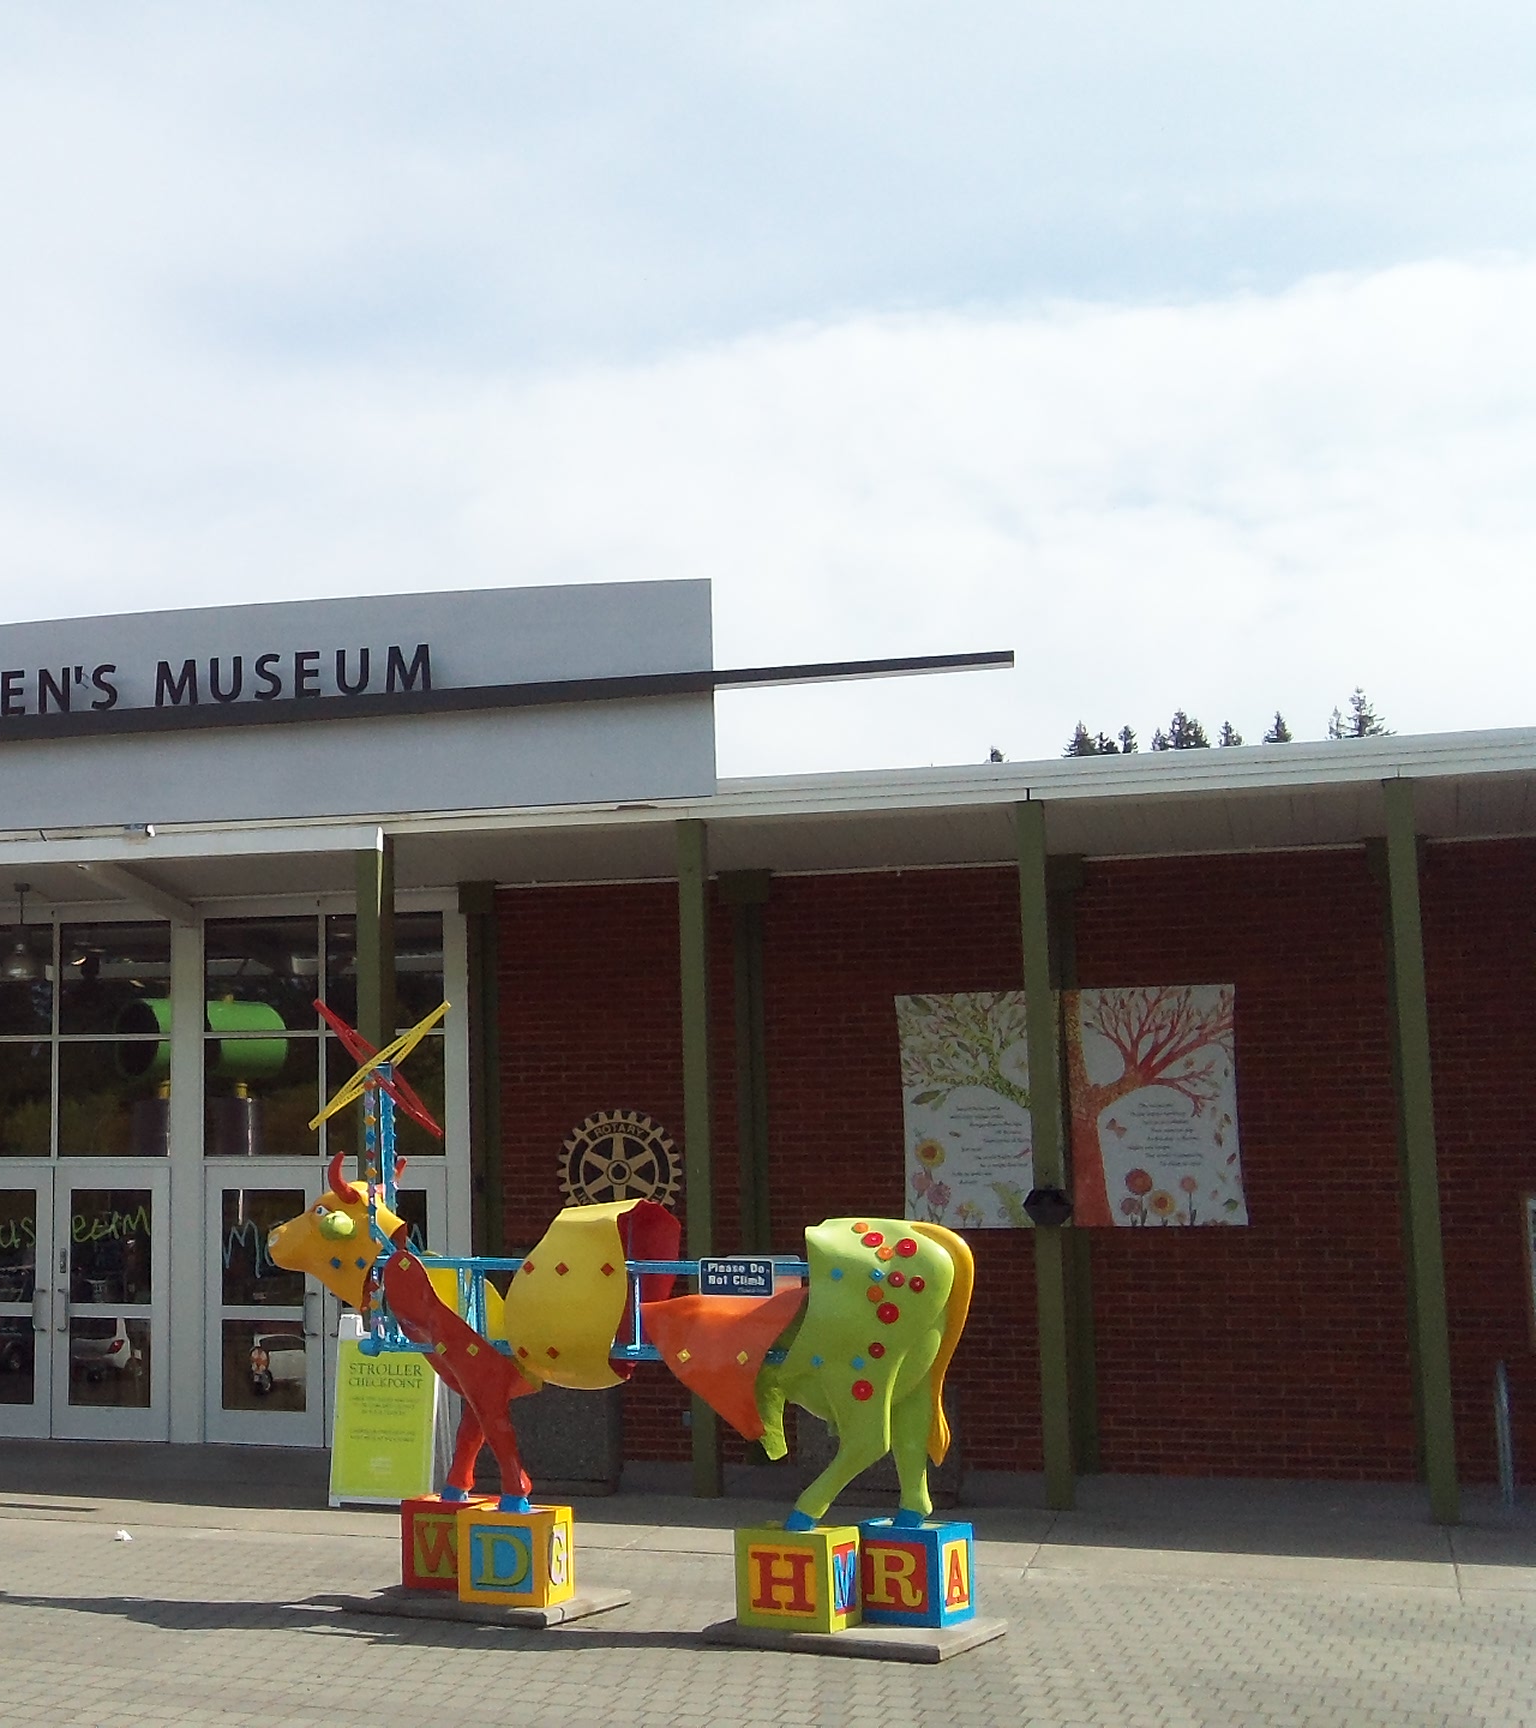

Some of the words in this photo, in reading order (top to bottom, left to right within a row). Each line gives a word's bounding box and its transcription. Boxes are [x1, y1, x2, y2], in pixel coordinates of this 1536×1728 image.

[154, 642, 432, 706] MUSEUM
[593, 1122, 645, 1138] ROTARY
[707, 1262, 745, 1273] Please
[750, 1263, 765, 1274] Do
[708, 1275, 728, 1286] Not
[732, 1275, 766, 1287] Climb
[348, 1362, 424, 1377] STROLLER
[348, 1377, 424, 1390] CHECKPOINT
[474, 1532, 530, 1587] D
[750, 1551, 815, 1613] H
[864, 1547, 924, 1608] R
[945, 1548, 968, 1608] A
